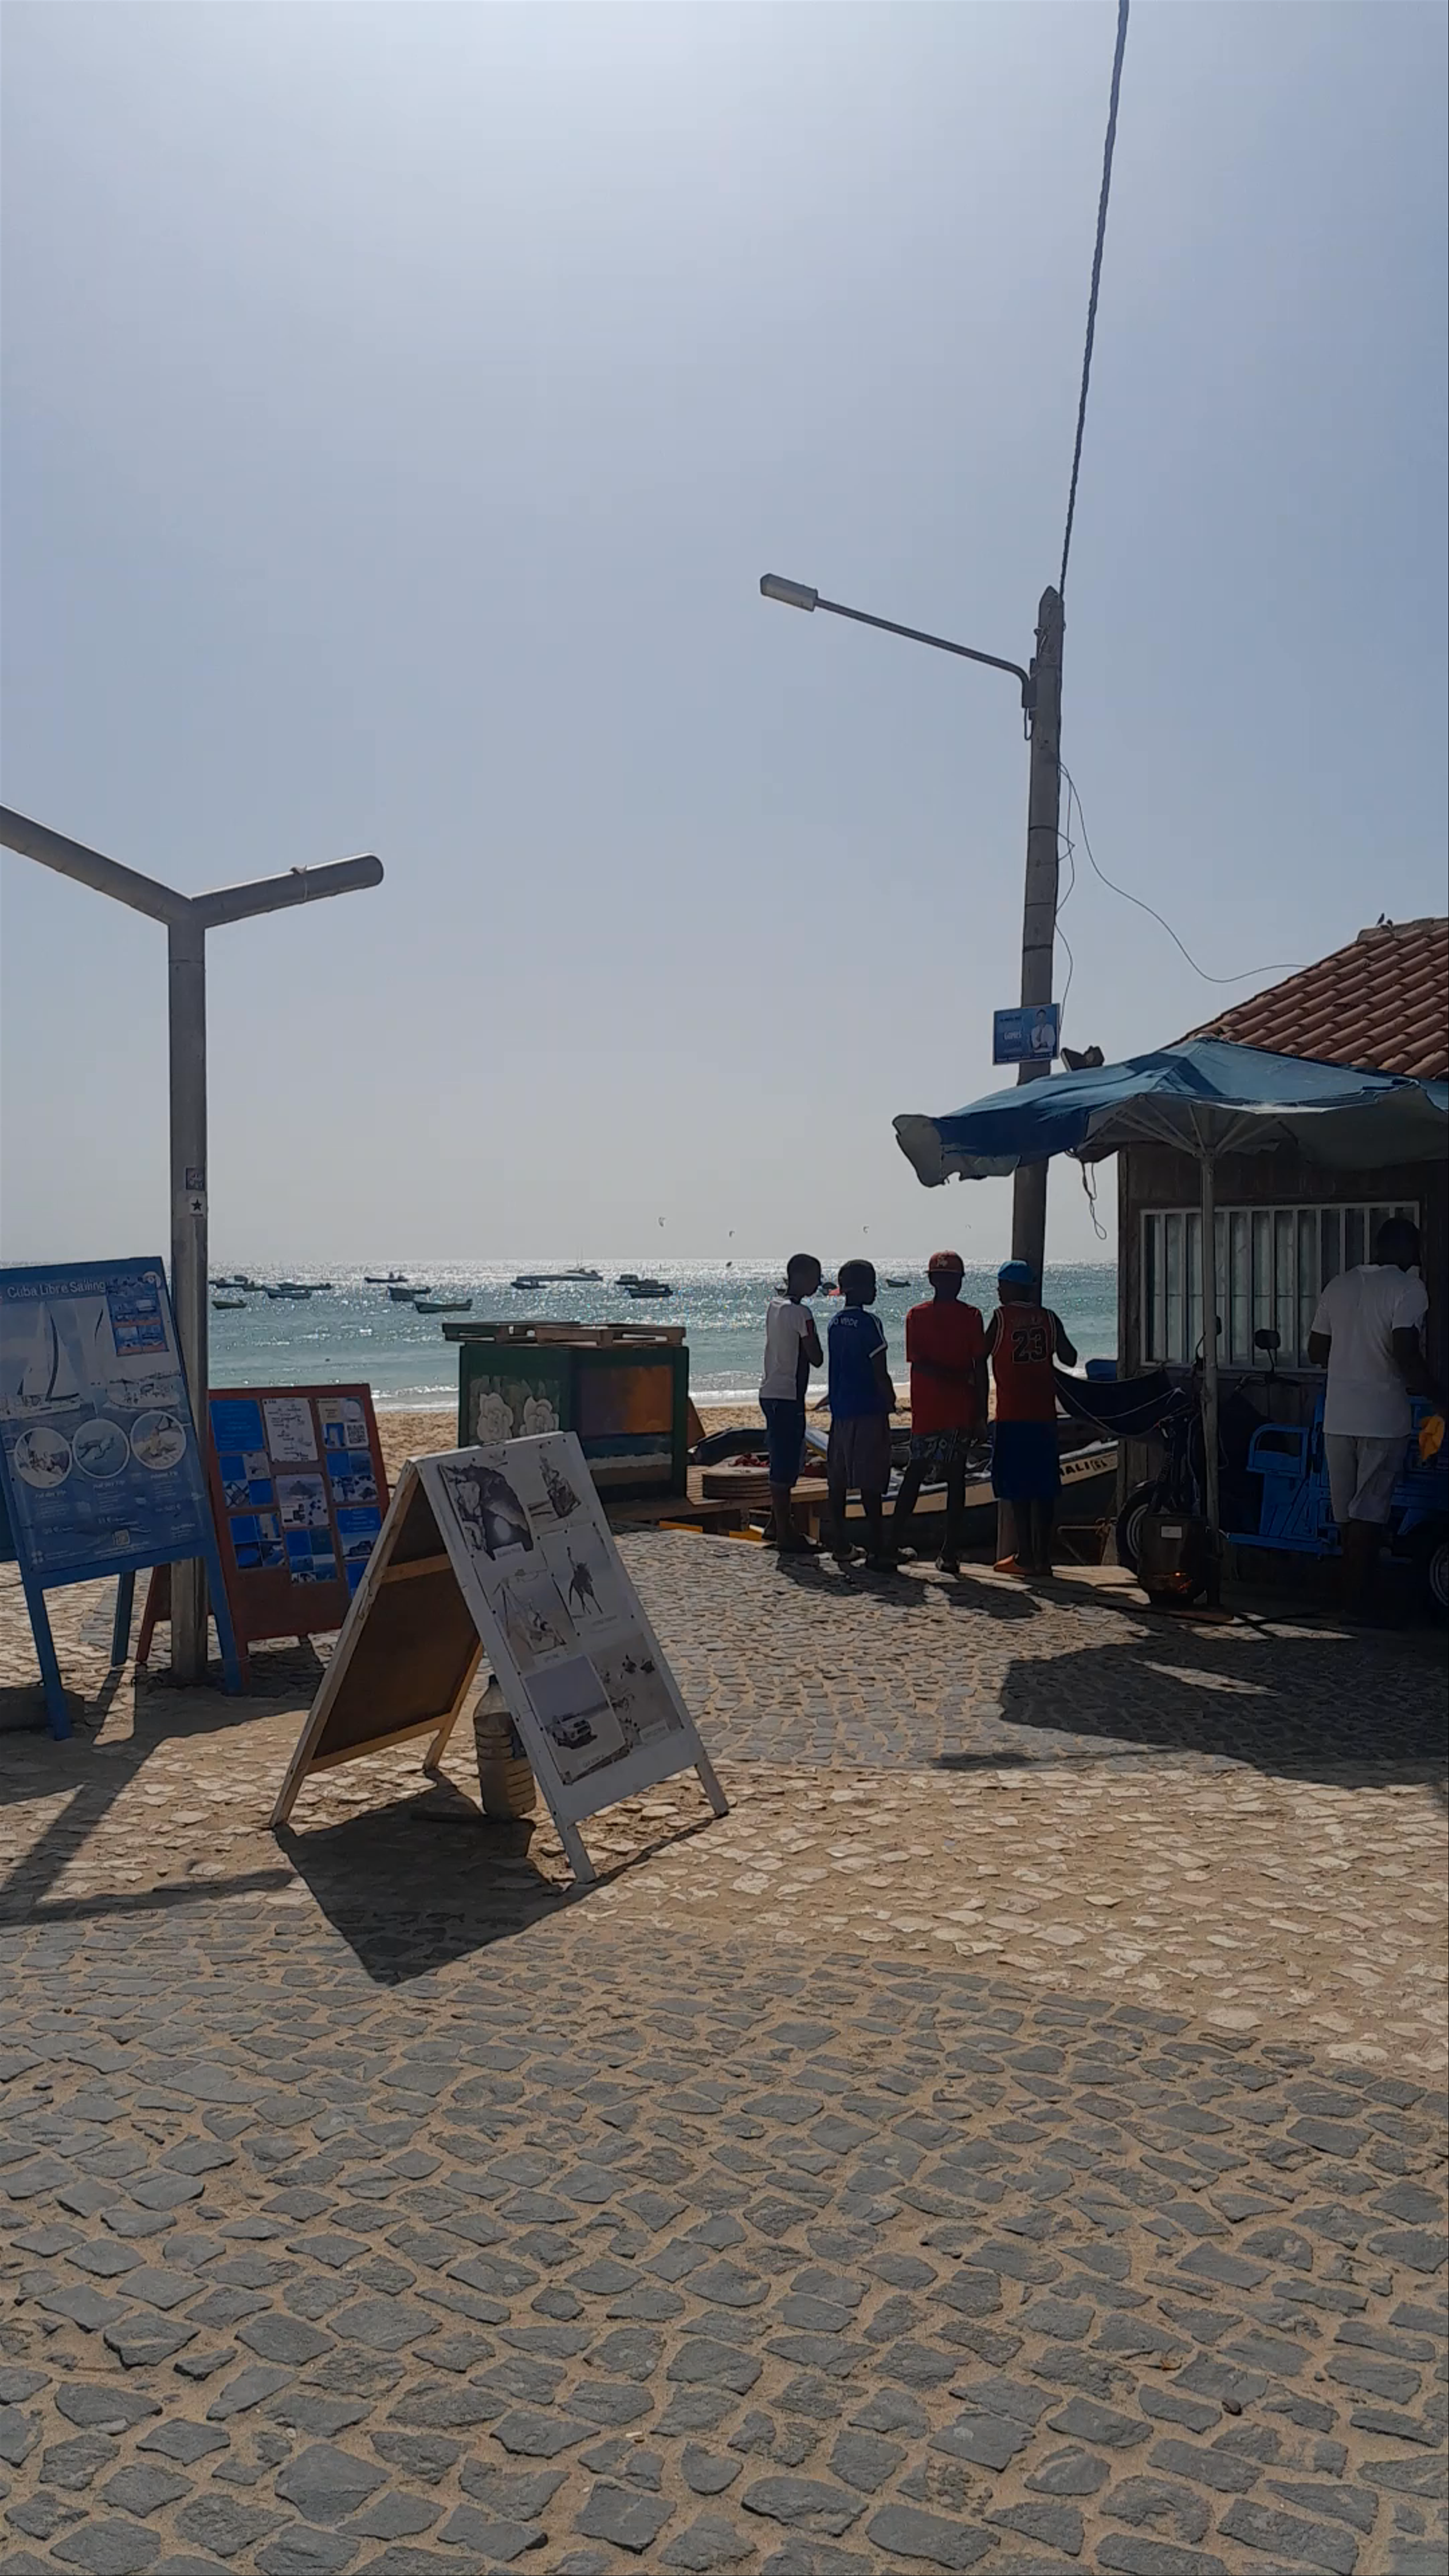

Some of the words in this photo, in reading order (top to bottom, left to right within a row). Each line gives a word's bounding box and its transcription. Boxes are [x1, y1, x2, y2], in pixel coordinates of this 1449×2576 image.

[7, 1285, 38, 1298] Cuba
[39, 1283, 69, 1295] Libre
[69, 1278, 106, 1292] Sailing
[1011, 1326, 1048, 1363] 23
